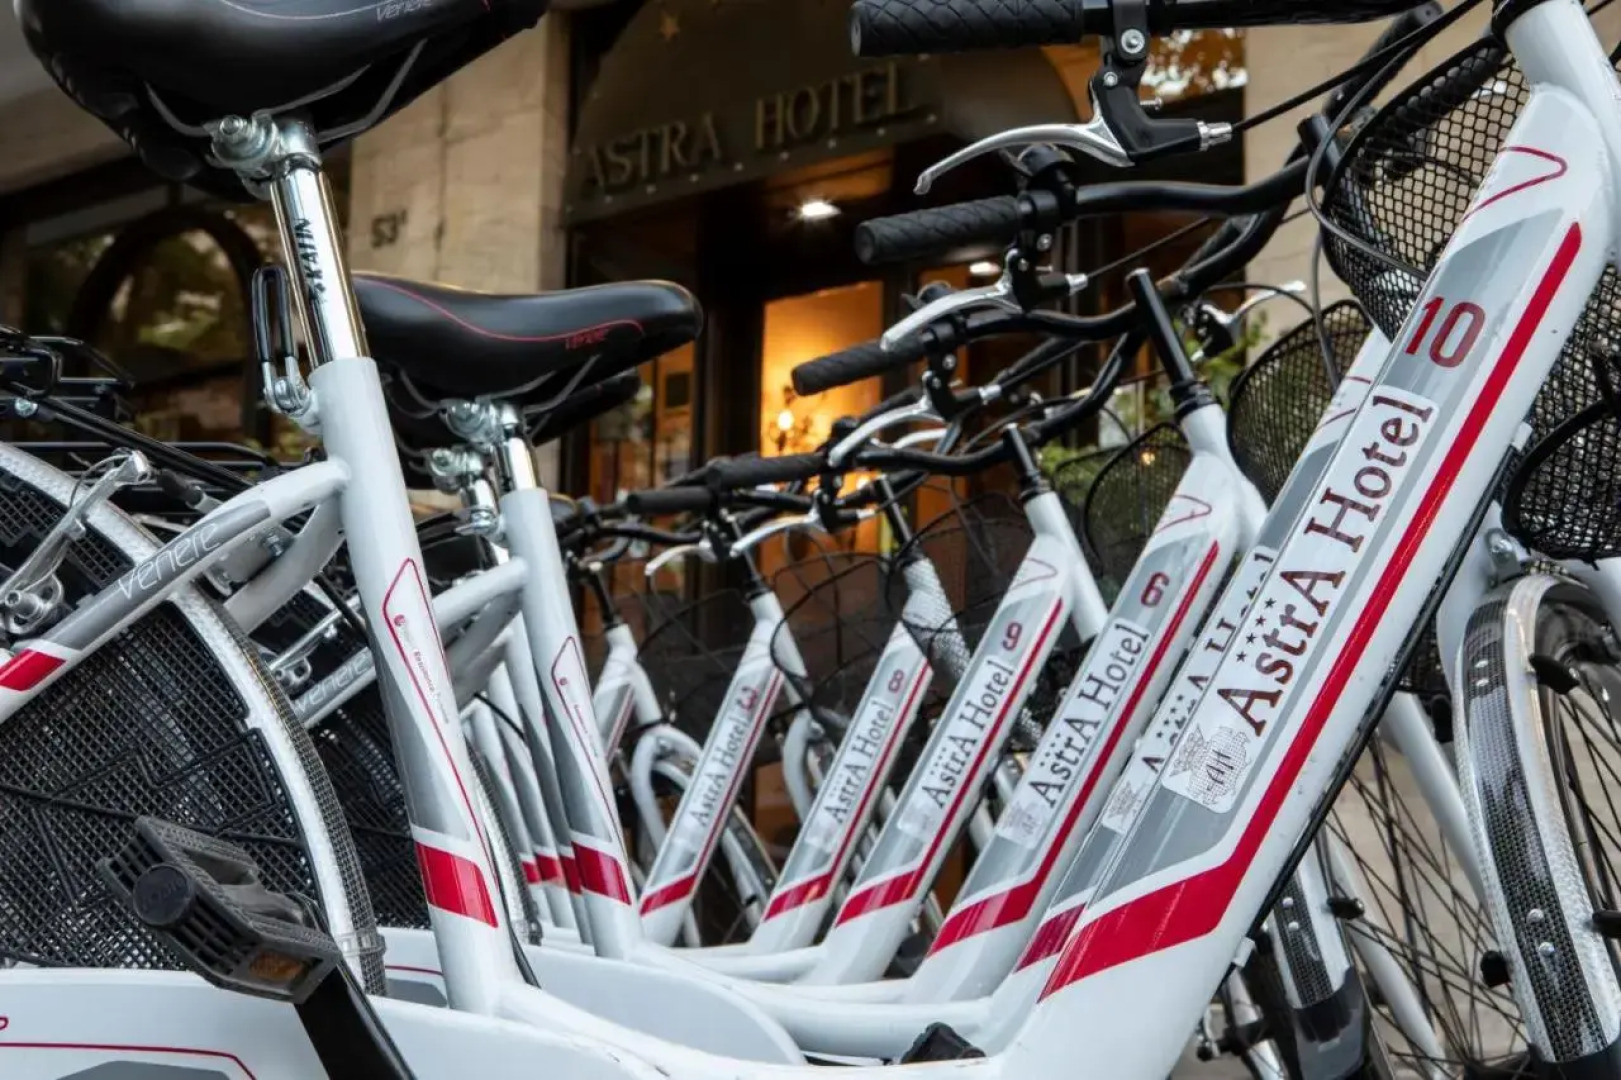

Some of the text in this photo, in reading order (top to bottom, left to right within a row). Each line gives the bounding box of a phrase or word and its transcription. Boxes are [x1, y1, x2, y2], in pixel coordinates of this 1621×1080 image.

[587, 61, 912, 188] ASTRA HOTEL
[1404, 296, 1486, 368] 10
[1140, 571, 1170, 608] 6
[1217, 570, 1346, 738] AstrA
[1304, 395, 1434, 553] Hotel
[888, 668, 904, 693] 8
[1002, 621, 1023, 651] 9
[712, 715, 750, 768] Hotel
[824, 699, 895, 824] AstrA Hotel
[922, 659, 1014, 809] AstrA Hotel
[1028, 623, 1150, 808] AstrA Hotel
